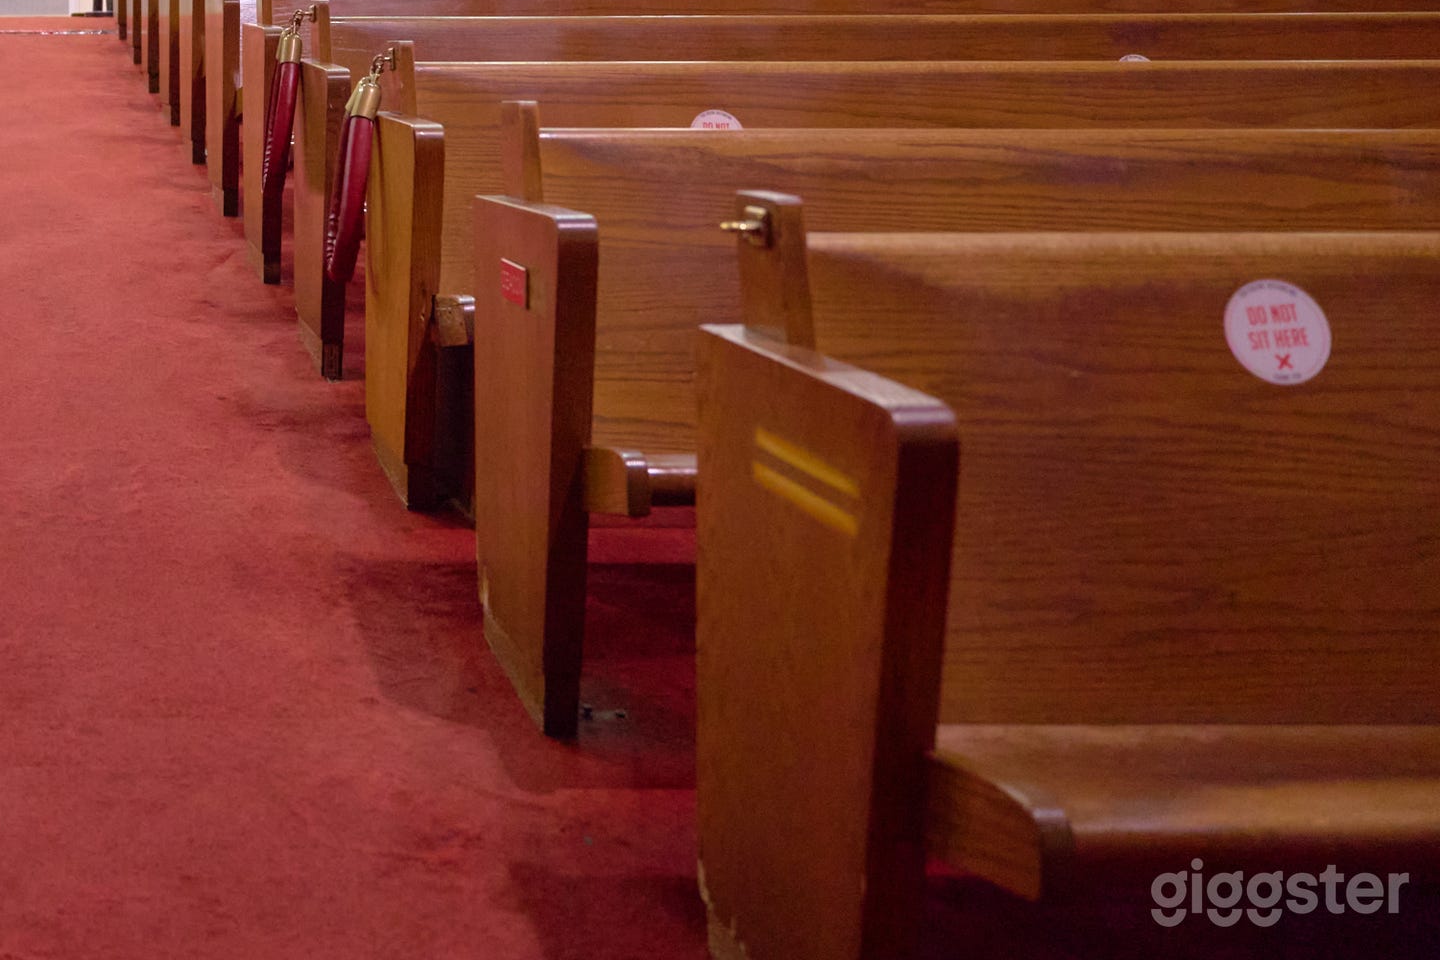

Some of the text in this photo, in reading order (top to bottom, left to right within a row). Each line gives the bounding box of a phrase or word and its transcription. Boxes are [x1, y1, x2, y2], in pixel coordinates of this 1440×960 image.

[1246, 303, 1298, 327] DO NOT
[1247, 327, 1309, 352] SIT HERE
